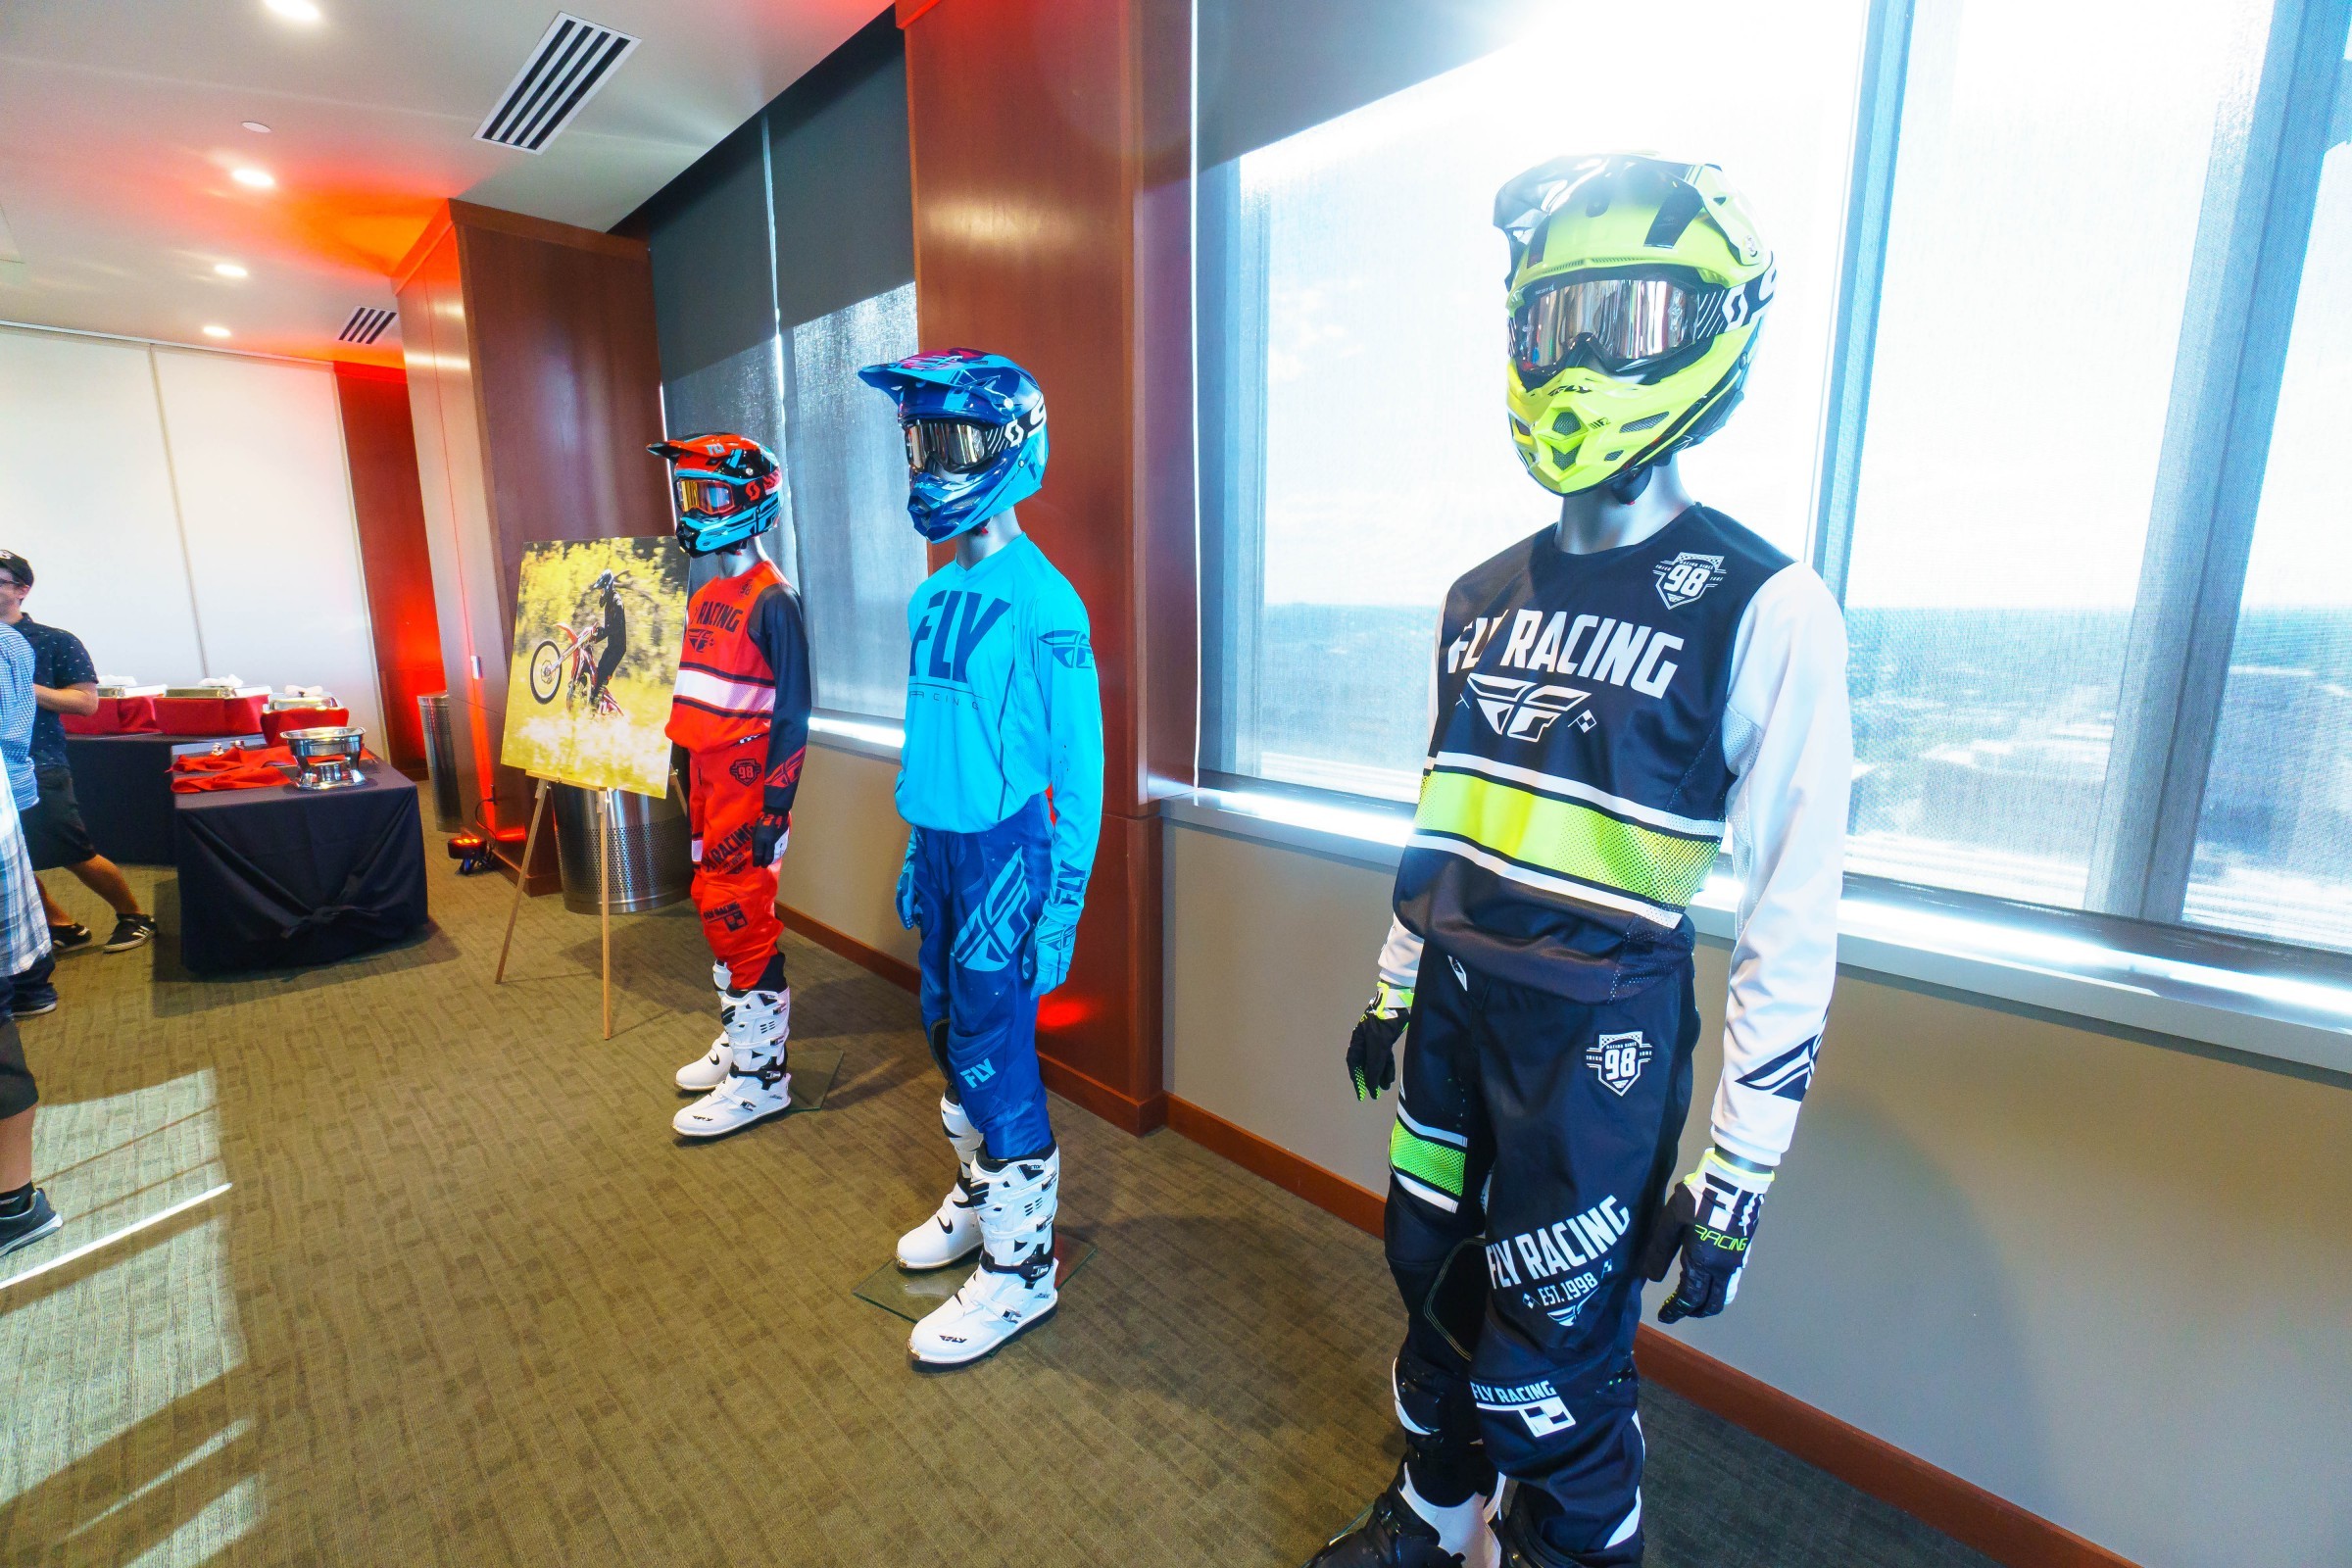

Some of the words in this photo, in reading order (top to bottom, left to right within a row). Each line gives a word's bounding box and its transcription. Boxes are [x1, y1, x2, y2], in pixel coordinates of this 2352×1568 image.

[1663, 564, 1711, 597] 98
[697, 601, 744, 633] RACING
[908, 589, 1012, 684] FLY
[1499, 608, 1686, 700] RACING
[738, 765, 754, 779] 98
[959, 1057, 997, 1088] FLY
[1604, 1047, 1637, 1081] 98
[1485, 1240, 1522, 1290] FLY
[1515, 1195, 1631, 1280] RACING
[1694, 1224, 1748, 1251] RACING
[1469, 1381, 1495, 1402] FLY
[1494, 1379, 1558, 1403] RACING
